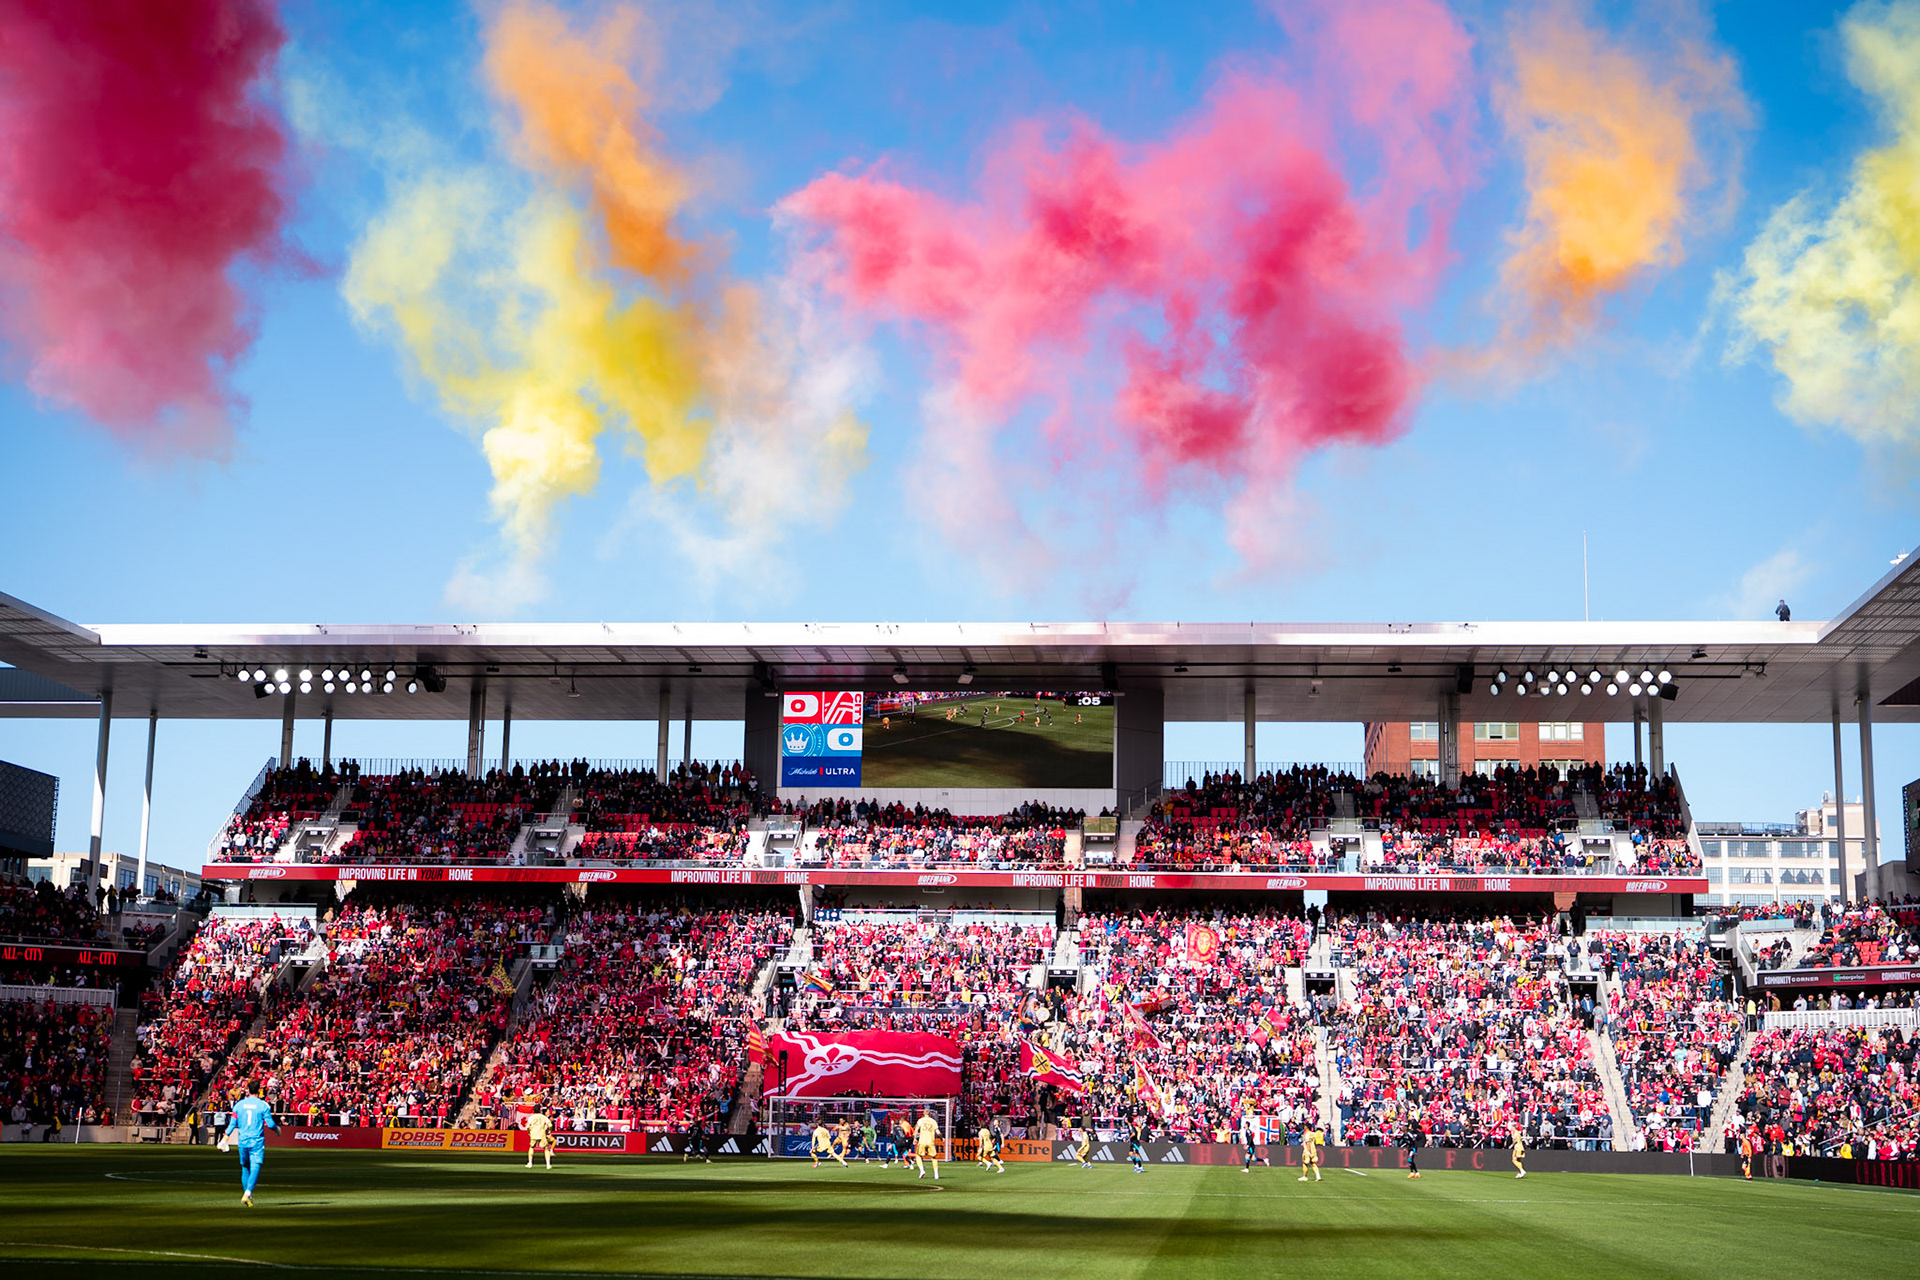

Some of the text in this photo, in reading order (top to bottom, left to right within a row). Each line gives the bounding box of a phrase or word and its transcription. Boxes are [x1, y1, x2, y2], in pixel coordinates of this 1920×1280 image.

[1078, 697, 1101, 705] :05
[825, 767, 856, 775] ULTRA
[249, 868, 281, 876] HOFFMANN
[339, 868, 473, 881] IMPROVING LIFE IN YOUR HOME
[671, 870, 809, 884] IMPROVING LIFE IN YOUR HOME
[918, 875, 952, 883] HOFFMANN
[1013, 874, 1155, 888] IMPROVING LIFE IN YOUR HOME
[1267, 880, 1301, 888] HOFFMANN
[1365, 878, 1510, 891] IMPROVING LIFE IN YOUR HOME
[2, 947, 17, 960] ALL
[24, 948, 44, 961] CITY
[77, 951, 93, 964] ALL
[99, 952, 118, 965] CITY
[1764, 976, 1791, 985] COMMUNITY
[1882, 972, 1910, 981] COMMUNITY
[246, 1110, 252, 1126] 1
[922, 1123, 933, 1132] 32
[294, 1132, 339, 1141] EQUIFAX
[389, 1131, 445, 1142] DOBBS
[452, 1132, 508, 1143] DOBBS
[556, 1136, 620, 1147] PURINA
[1015, 1143, 1050, 1155] Tire
